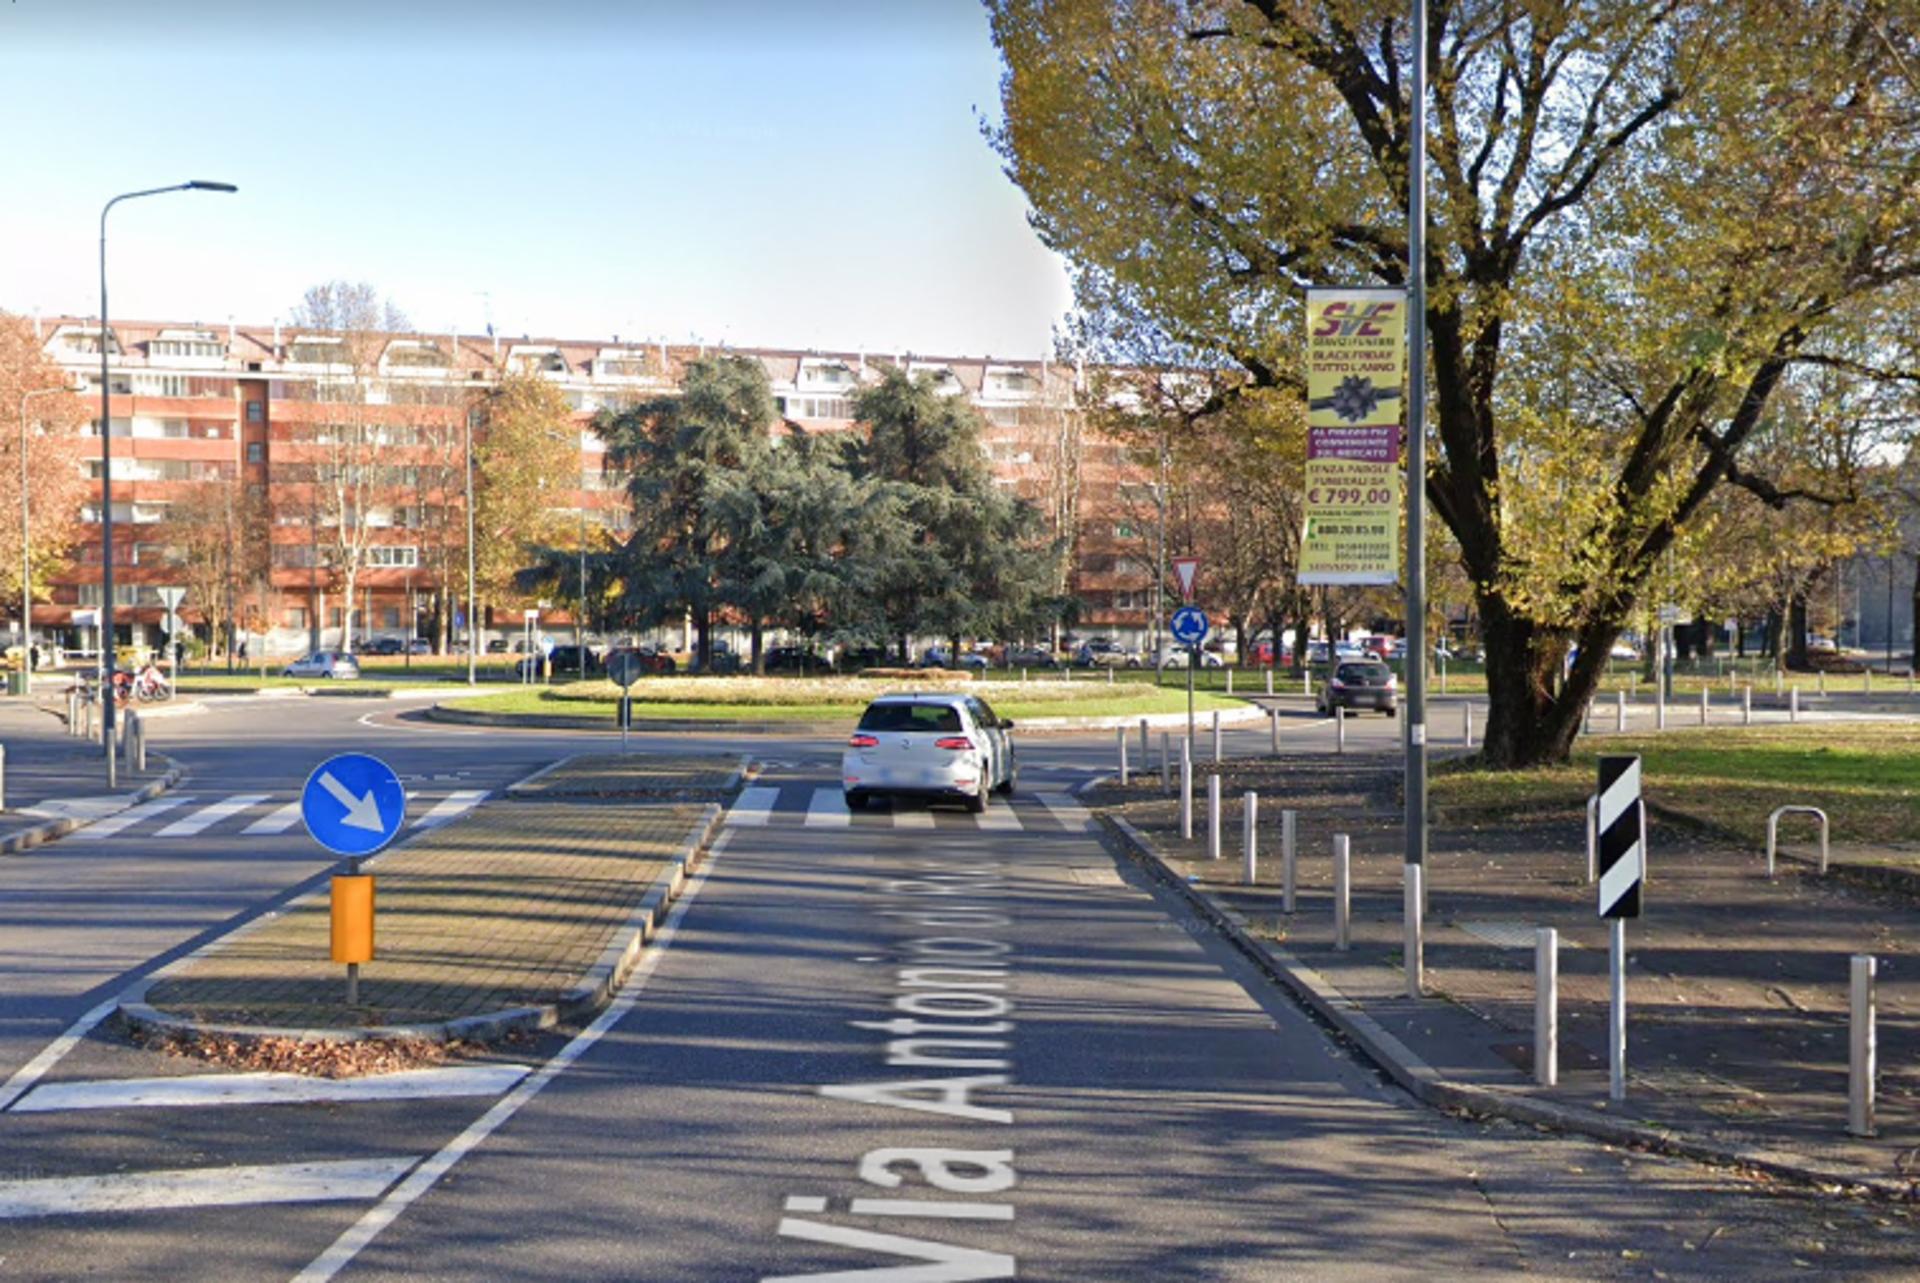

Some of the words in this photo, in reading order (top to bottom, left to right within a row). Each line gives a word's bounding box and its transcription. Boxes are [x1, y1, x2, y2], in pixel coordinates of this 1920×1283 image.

[1313, 363, 1349, 372] TUTTO
[1308, 487, 1320, 504] €
[1326, 487, 1391, 506] 799,00
